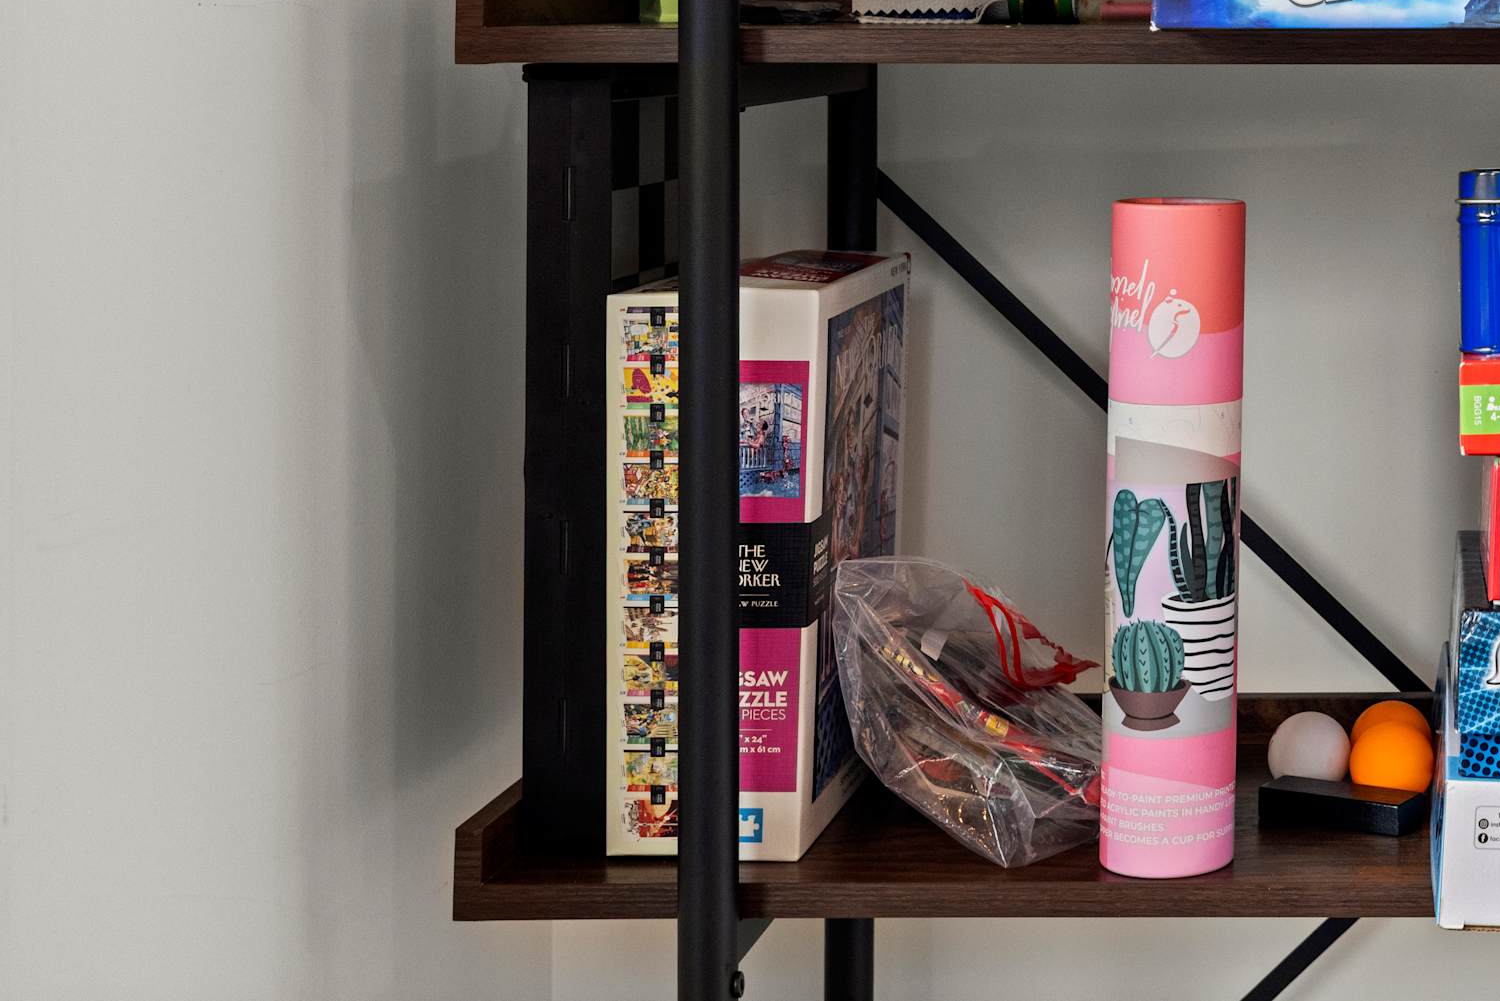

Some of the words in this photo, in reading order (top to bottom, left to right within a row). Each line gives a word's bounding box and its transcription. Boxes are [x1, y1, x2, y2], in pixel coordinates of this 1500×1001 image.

[739, 544, 766, 558] THE
[742, 709, 786, 720] PIECES
[1172, 834, 1194, 845] CUP
